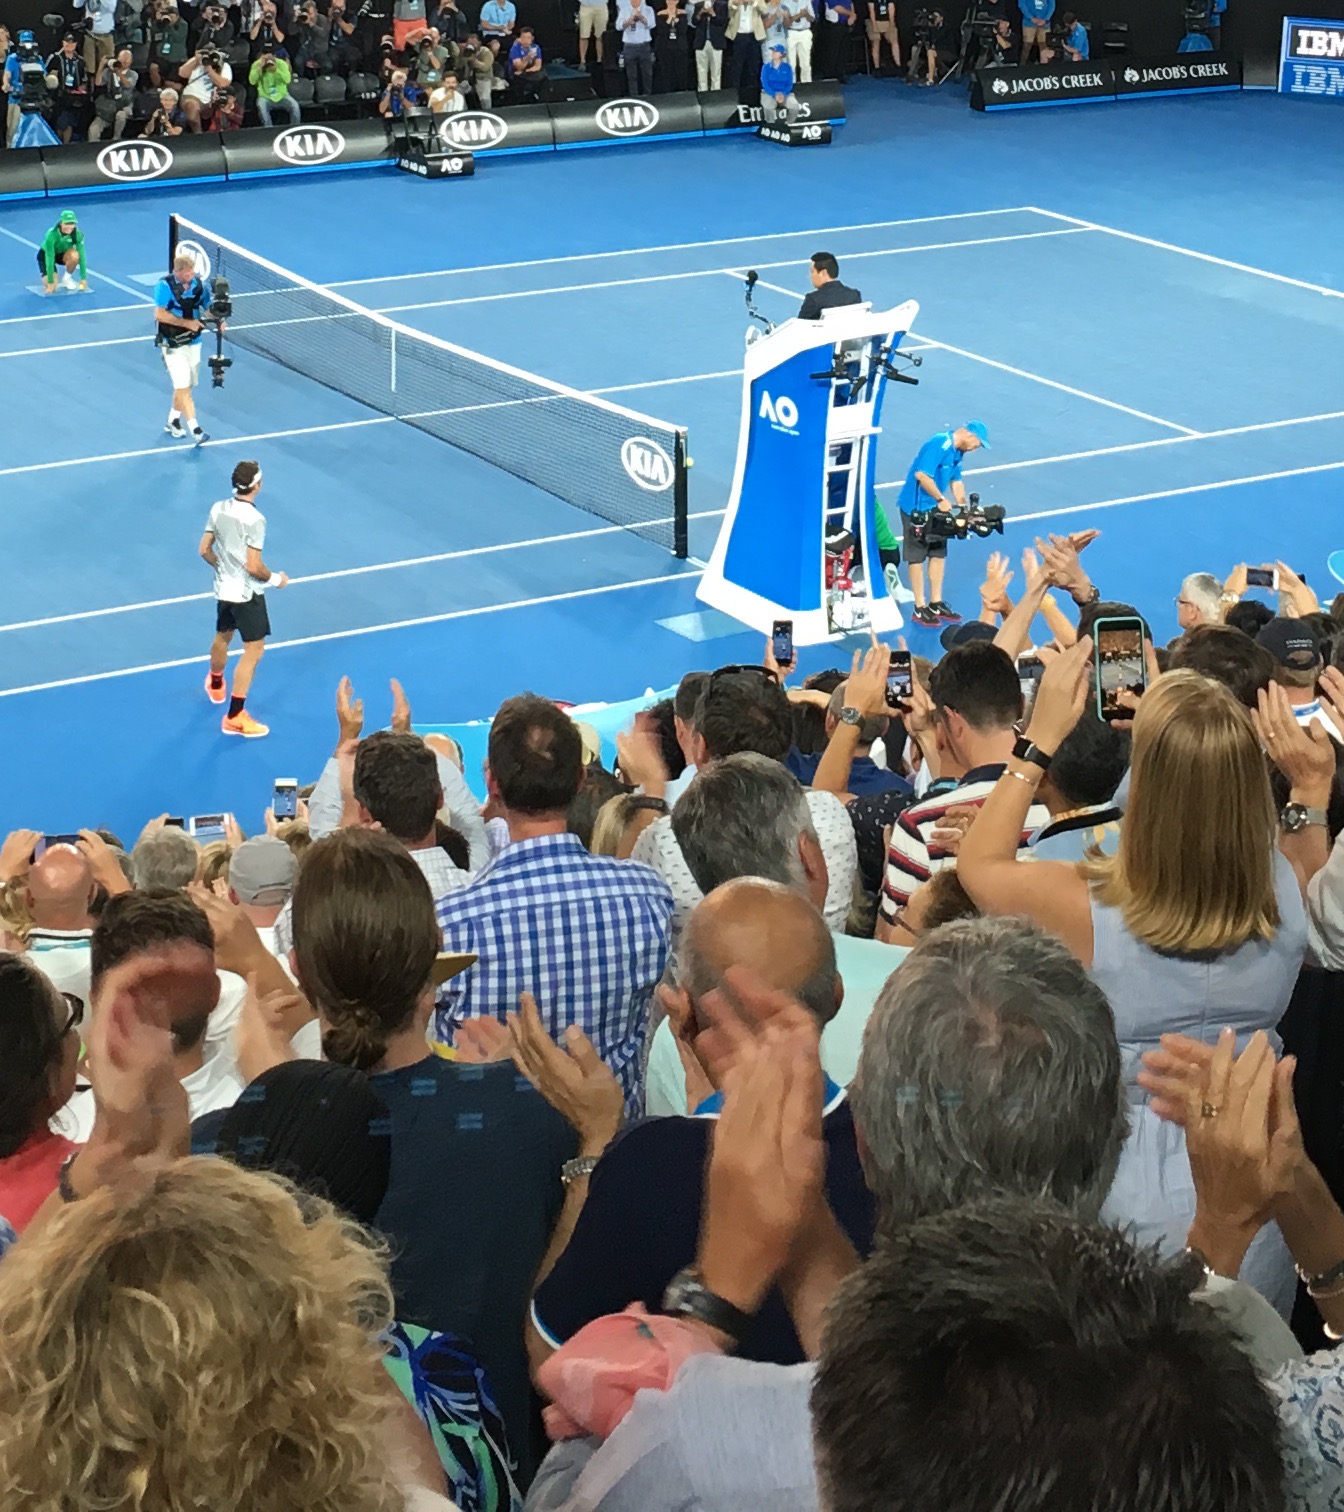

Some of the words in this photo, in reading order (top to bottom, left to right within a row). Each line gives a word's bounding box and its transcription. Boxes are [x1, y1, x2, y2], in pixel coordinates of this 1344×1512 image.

[1011, 74, 1060, 95] JACOB'S
[1062, 73, 1103, 90] CREEK
[1141, 65, 1188, 84] JACOB'S
[1190, 63, 1229, 80] CREEK
[605, 107, 648, 129] KIA
[451, 120, 497, 141] KIA
[802, 125, 822, 139] AO
[285, 132, 334, 156] KIA
[109, 147, 159, 173] KIA
[441, 158, 463, 173] AO
[759, 390, 799, 428] AO
[629, 448, 667, 480] KIA
